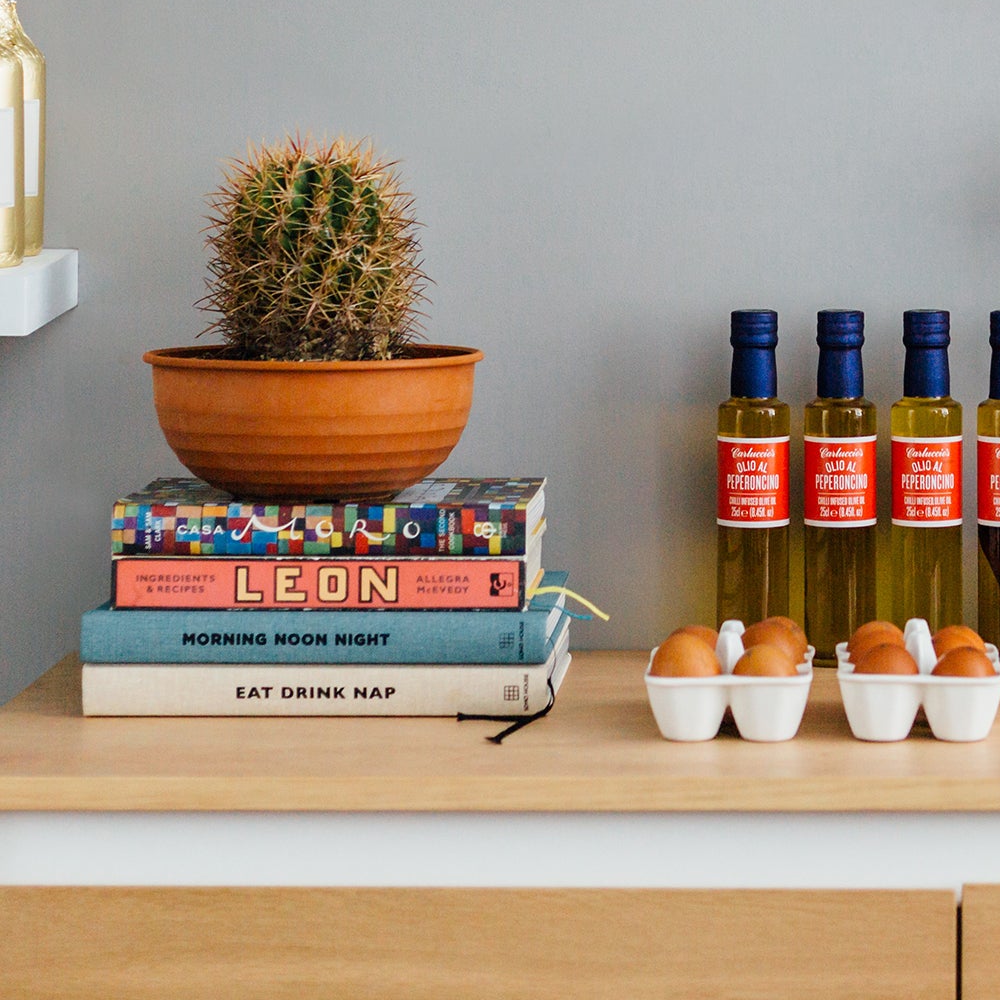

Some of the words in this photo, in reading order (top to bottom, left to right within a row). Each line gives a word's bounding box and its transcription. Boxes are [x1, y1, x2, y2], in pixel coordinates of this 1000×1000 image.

[731, 447, 776, 459] Carluccio's
[820, 447, 864, 459] Carluccio's
[906, 447, 950, 459] Carluccio's
[736, 460, 756, 473] OLIO
[758, 461, 768, 473] AL
[826, 460, 844, 473] OLIO
[846, 461, 856, 473] AL
[912, 460, 931, 473] OLIO
[932, 461, 942, 473] AL
[726, 474, 780, 491] PEPERONCINO
[816, 474, 868, 491] PEPERONCINO
[902, 474, 954, 491] PEPERONCINO
[176, 524, 224, 536] CASA
[231, 514, 421, 540] MORO
[136, 574, 216, 583] INGREDIENTS
[234, 566, 399, 603] LEON
[416, 586, 469, 594] McEVEDY
[182, 633, 267, 646] MORNING
[274, 633, 327, 646] NOON
[334, 633, 390, 647] NIGHT
[236, 686, 273, 699] EAT
[281, 686, 346, 699] DRINK
[353, 686, 396, 699] NAP
